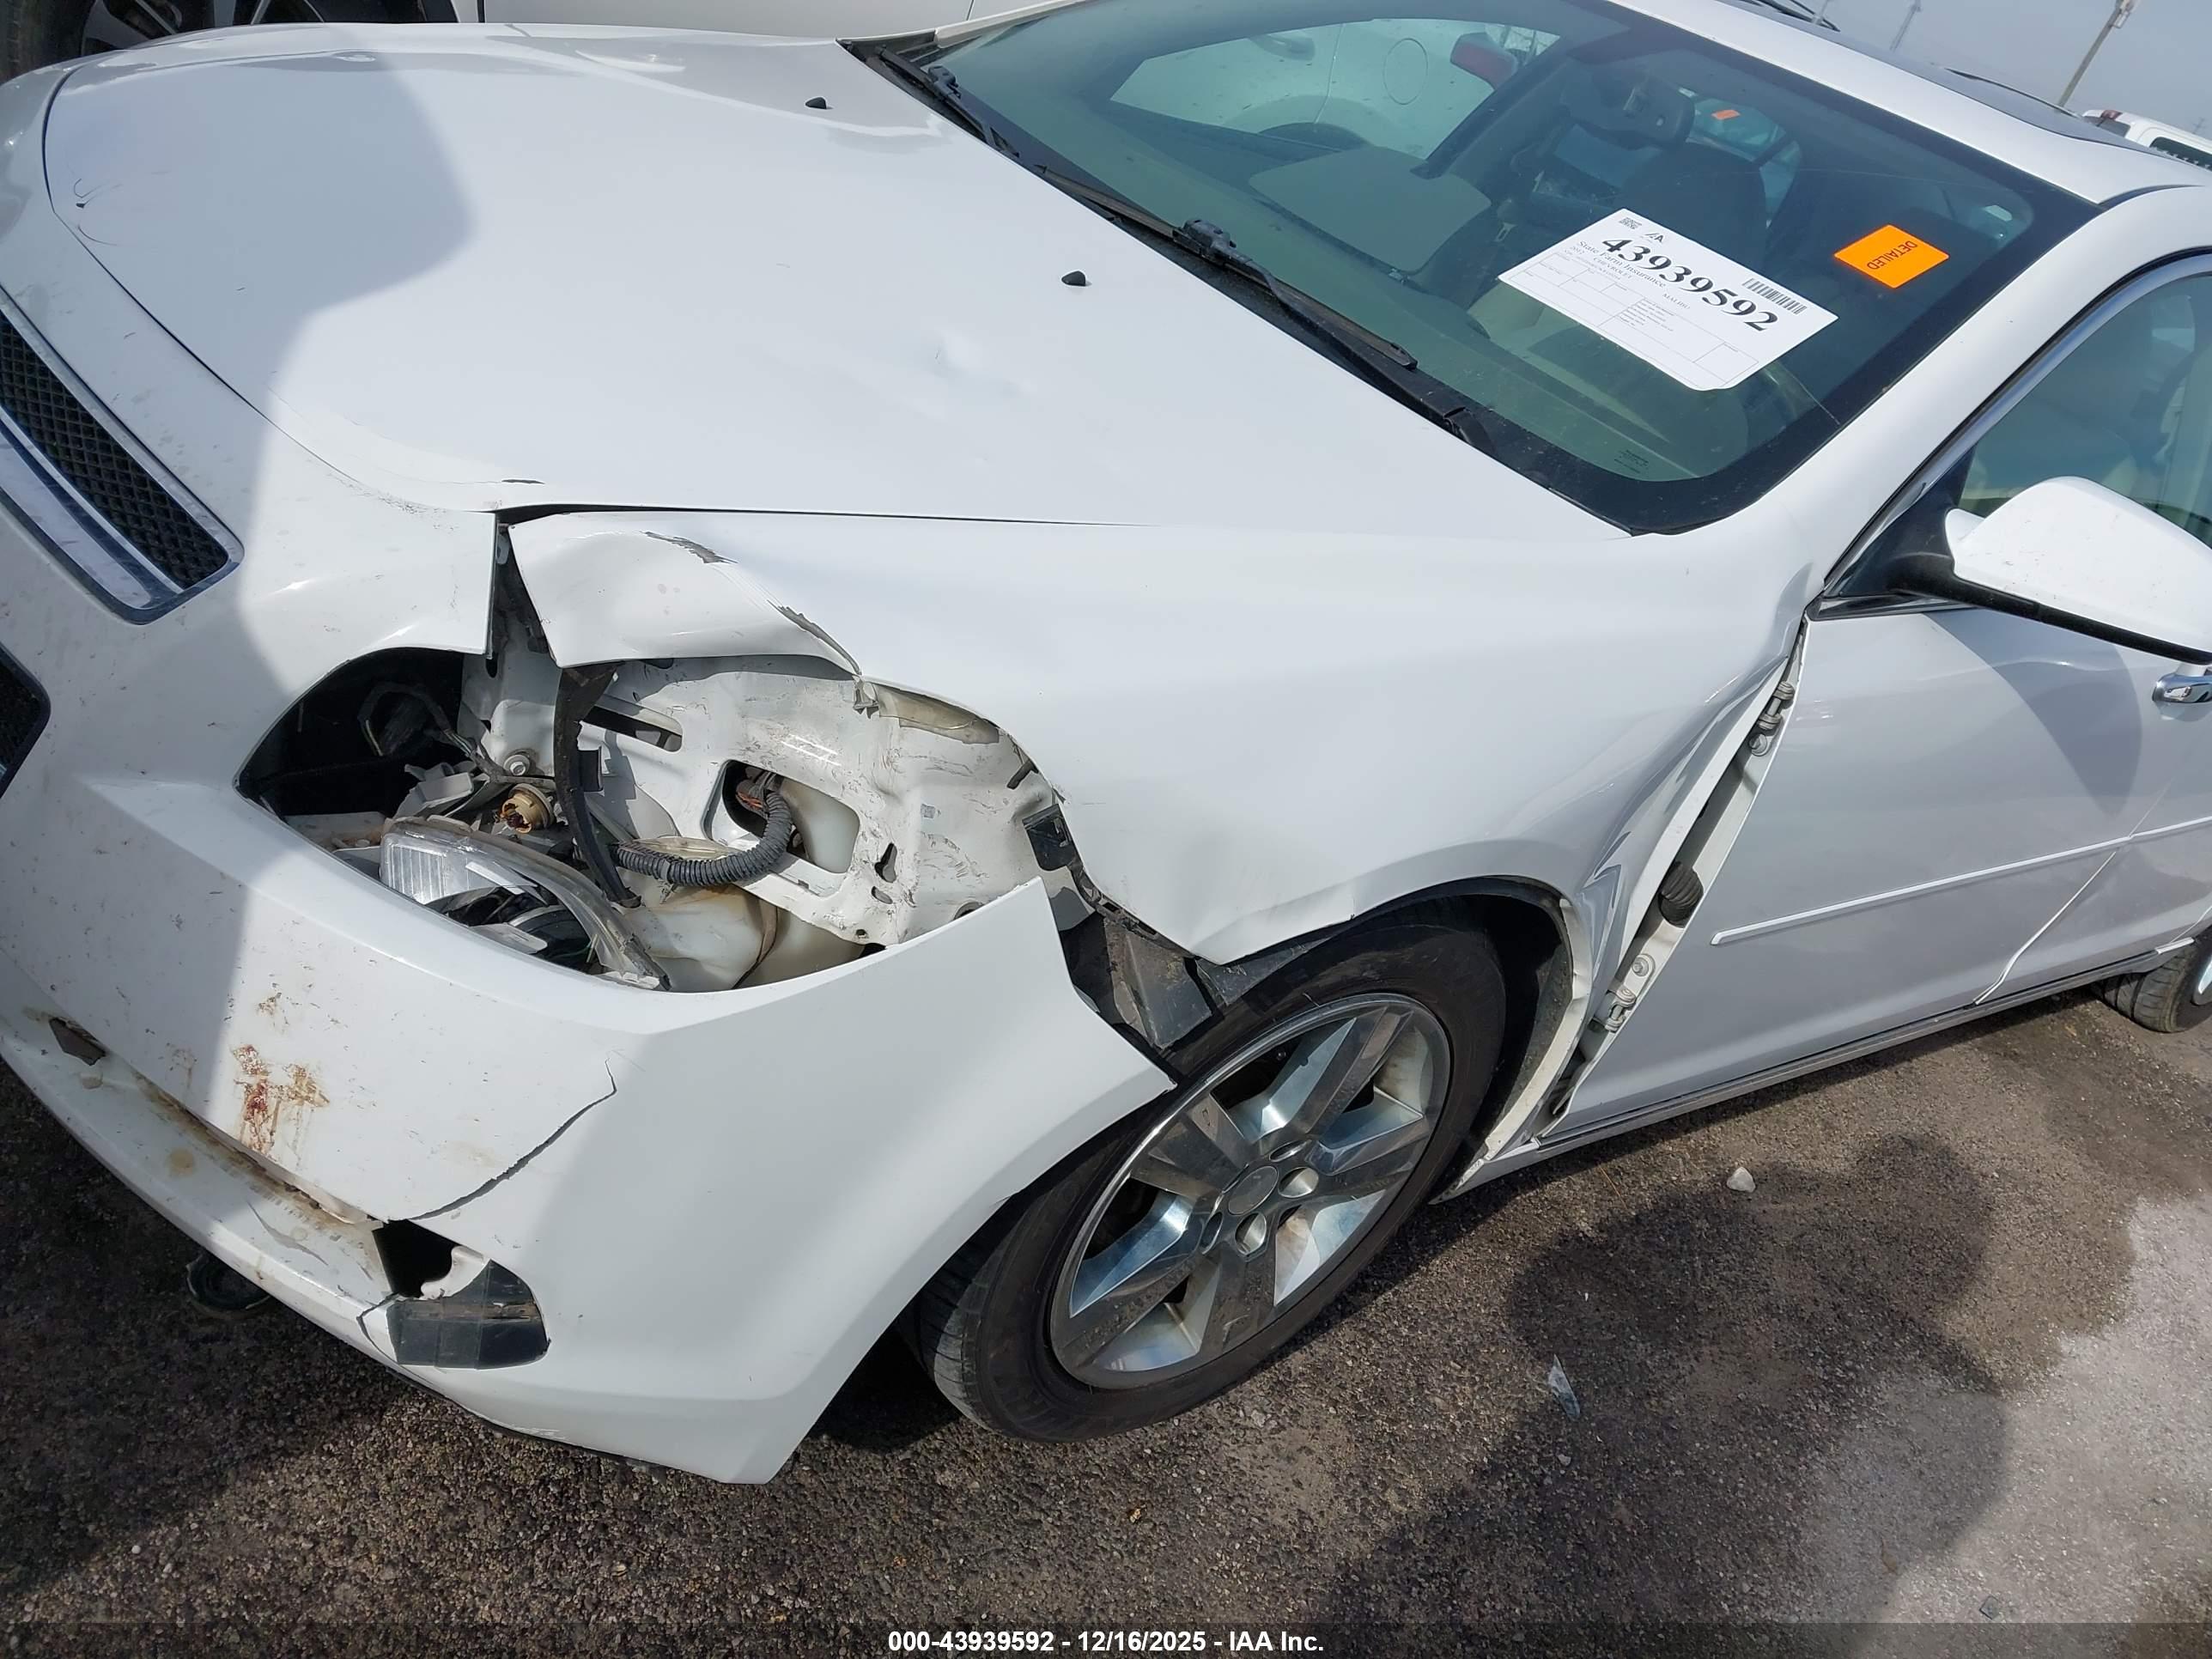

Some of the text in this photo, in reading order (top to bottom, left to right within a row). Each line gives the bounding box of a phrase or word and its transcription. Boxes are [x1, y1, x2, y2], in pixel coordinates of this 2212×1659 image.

[1578, 240, 1600, 254] State
[1601, 252, 1623, 267] Farm
[1623, 260, 1667, 289] Insurance
[1867, 240, 1918, 270] DETAILED
[1601, 239, 1778, 331] 43939592
